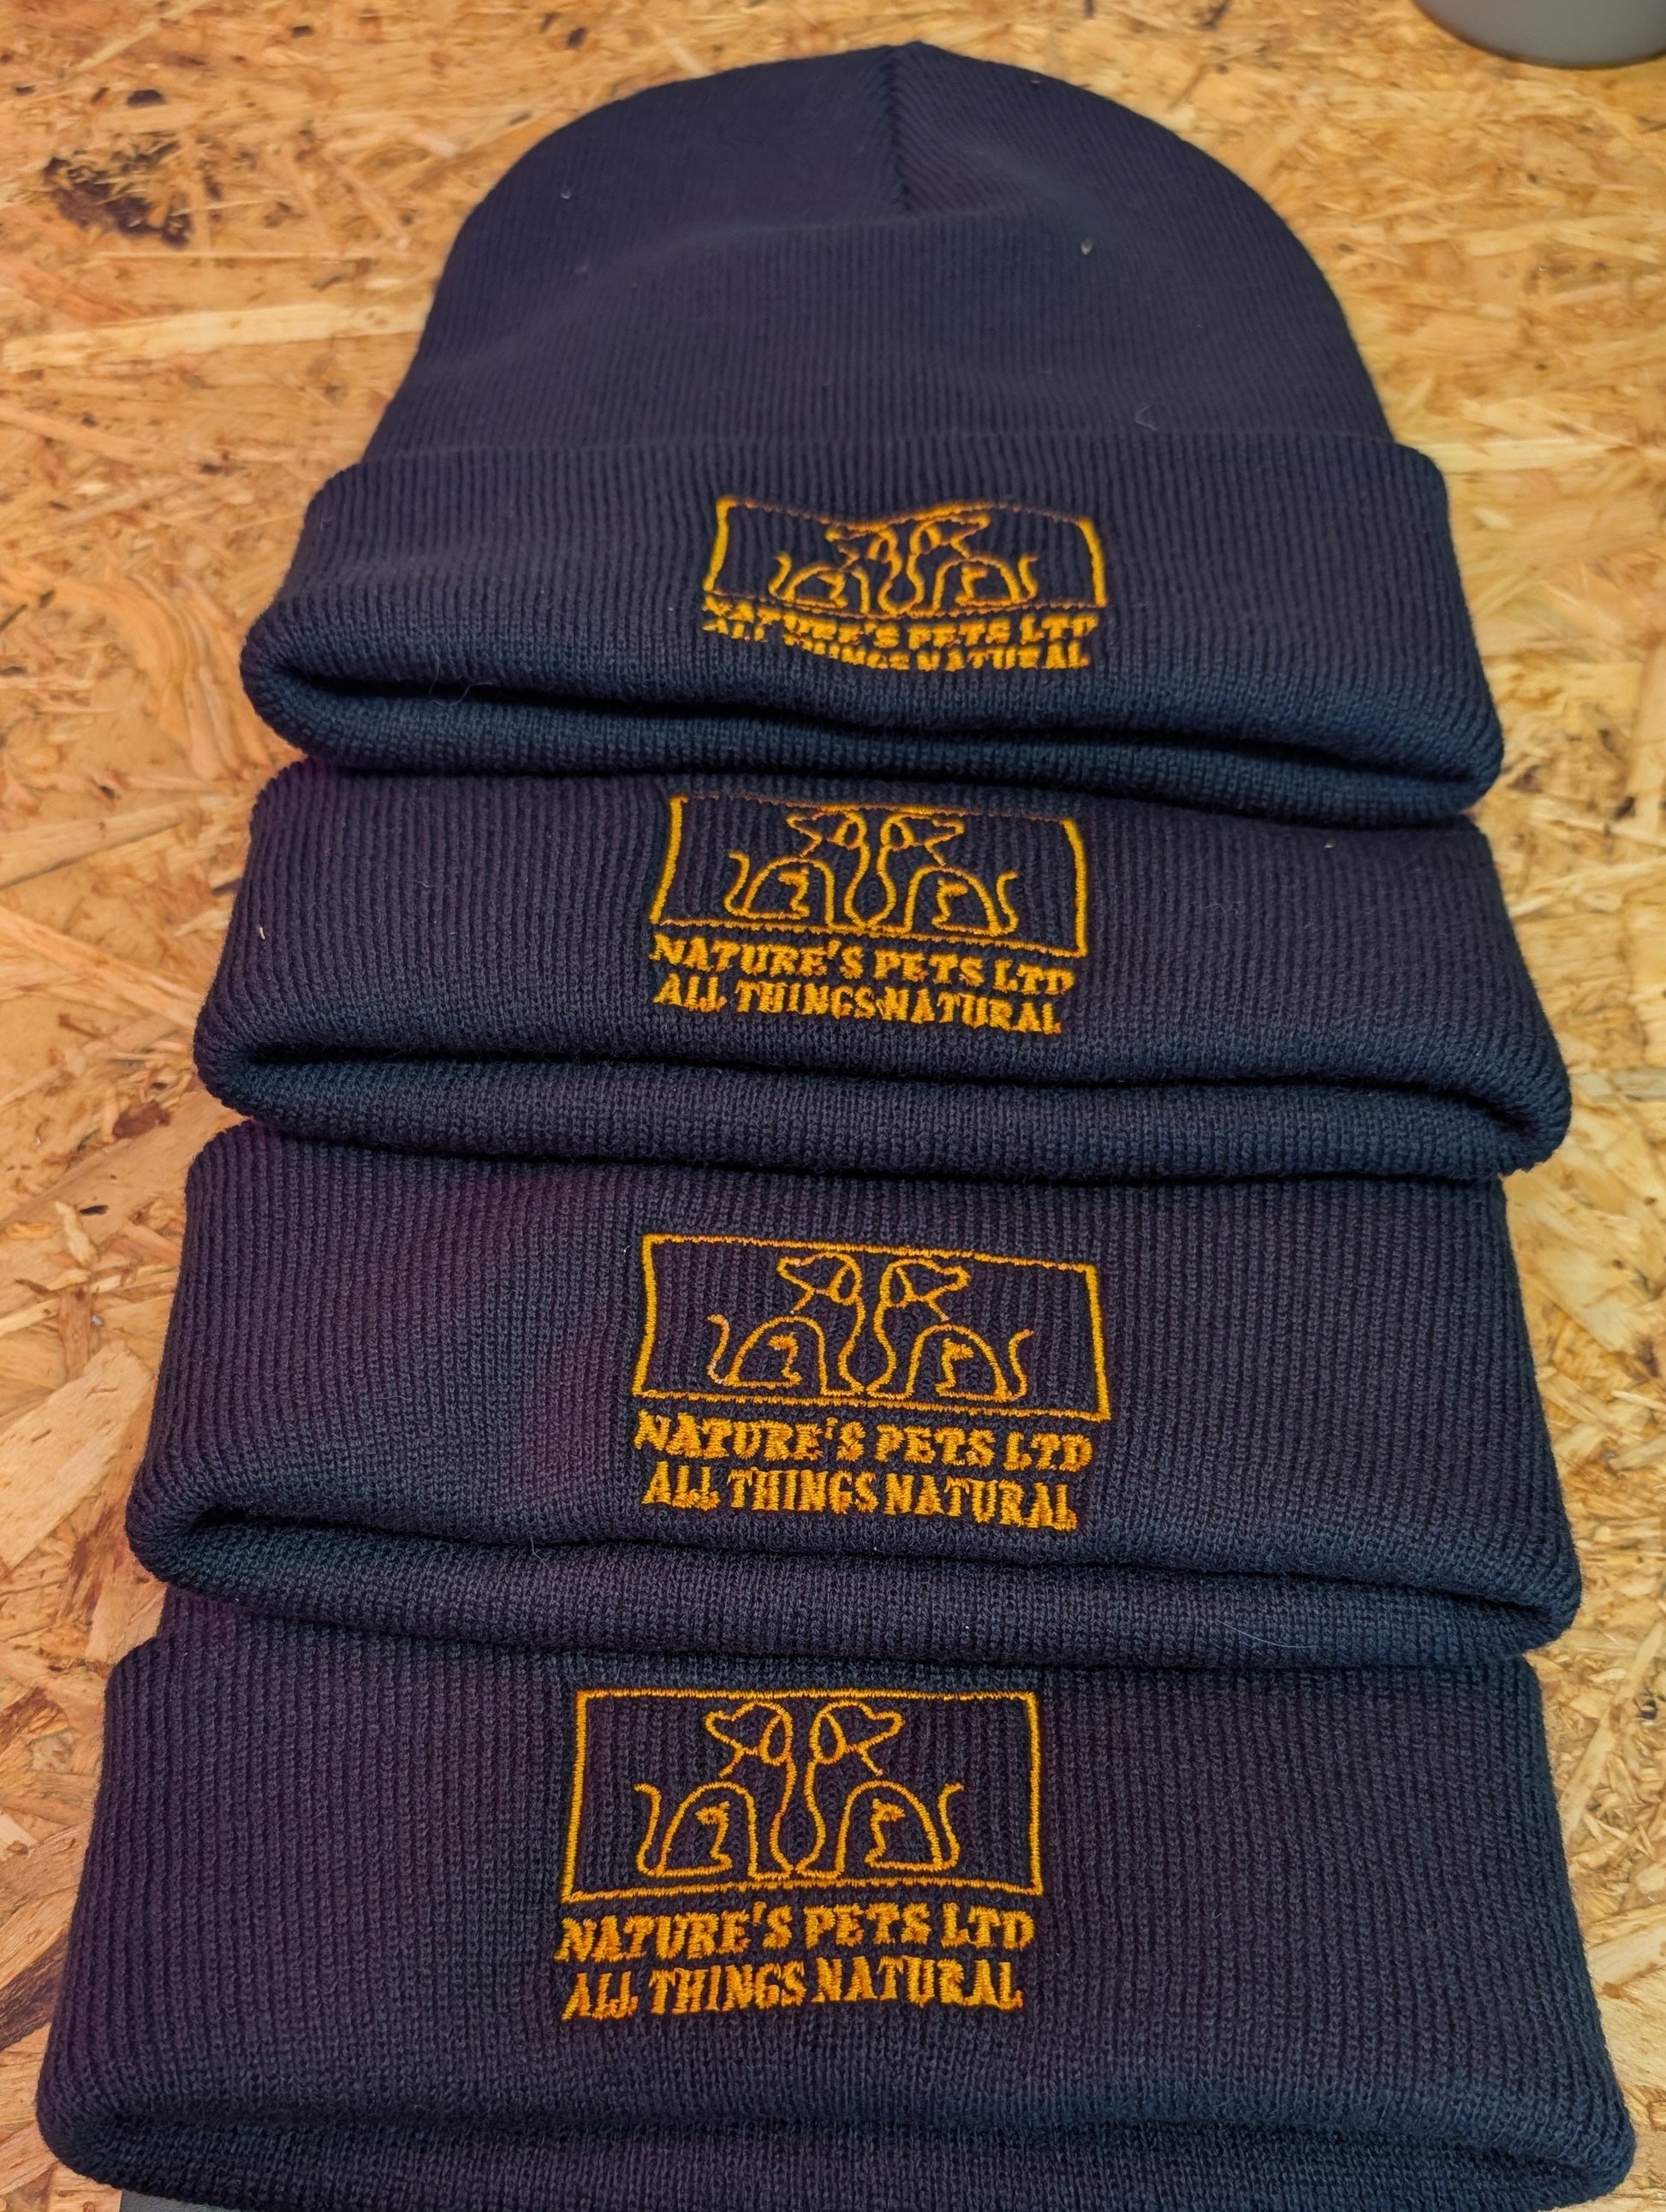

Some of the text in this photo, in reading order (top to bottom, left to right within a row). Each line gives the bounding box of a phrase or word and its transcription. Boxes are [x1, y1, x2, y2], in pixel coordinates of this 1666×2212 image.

[649, 932, 1075, 995] NATURE'S PETS LTD
[652, 972, 1062, 1034] ALL THINGS NATURAL
[634, 1409, 1092, 1472] NATURE'S PETS LTD
[641, 1461, 1078, 1531] ALL THINGS NATURAL
[554, 1901, 1035, 1962] NATURE'S PETS LTD
[562, 1954, 1023, 2021] ALL THINGS NATURAL
